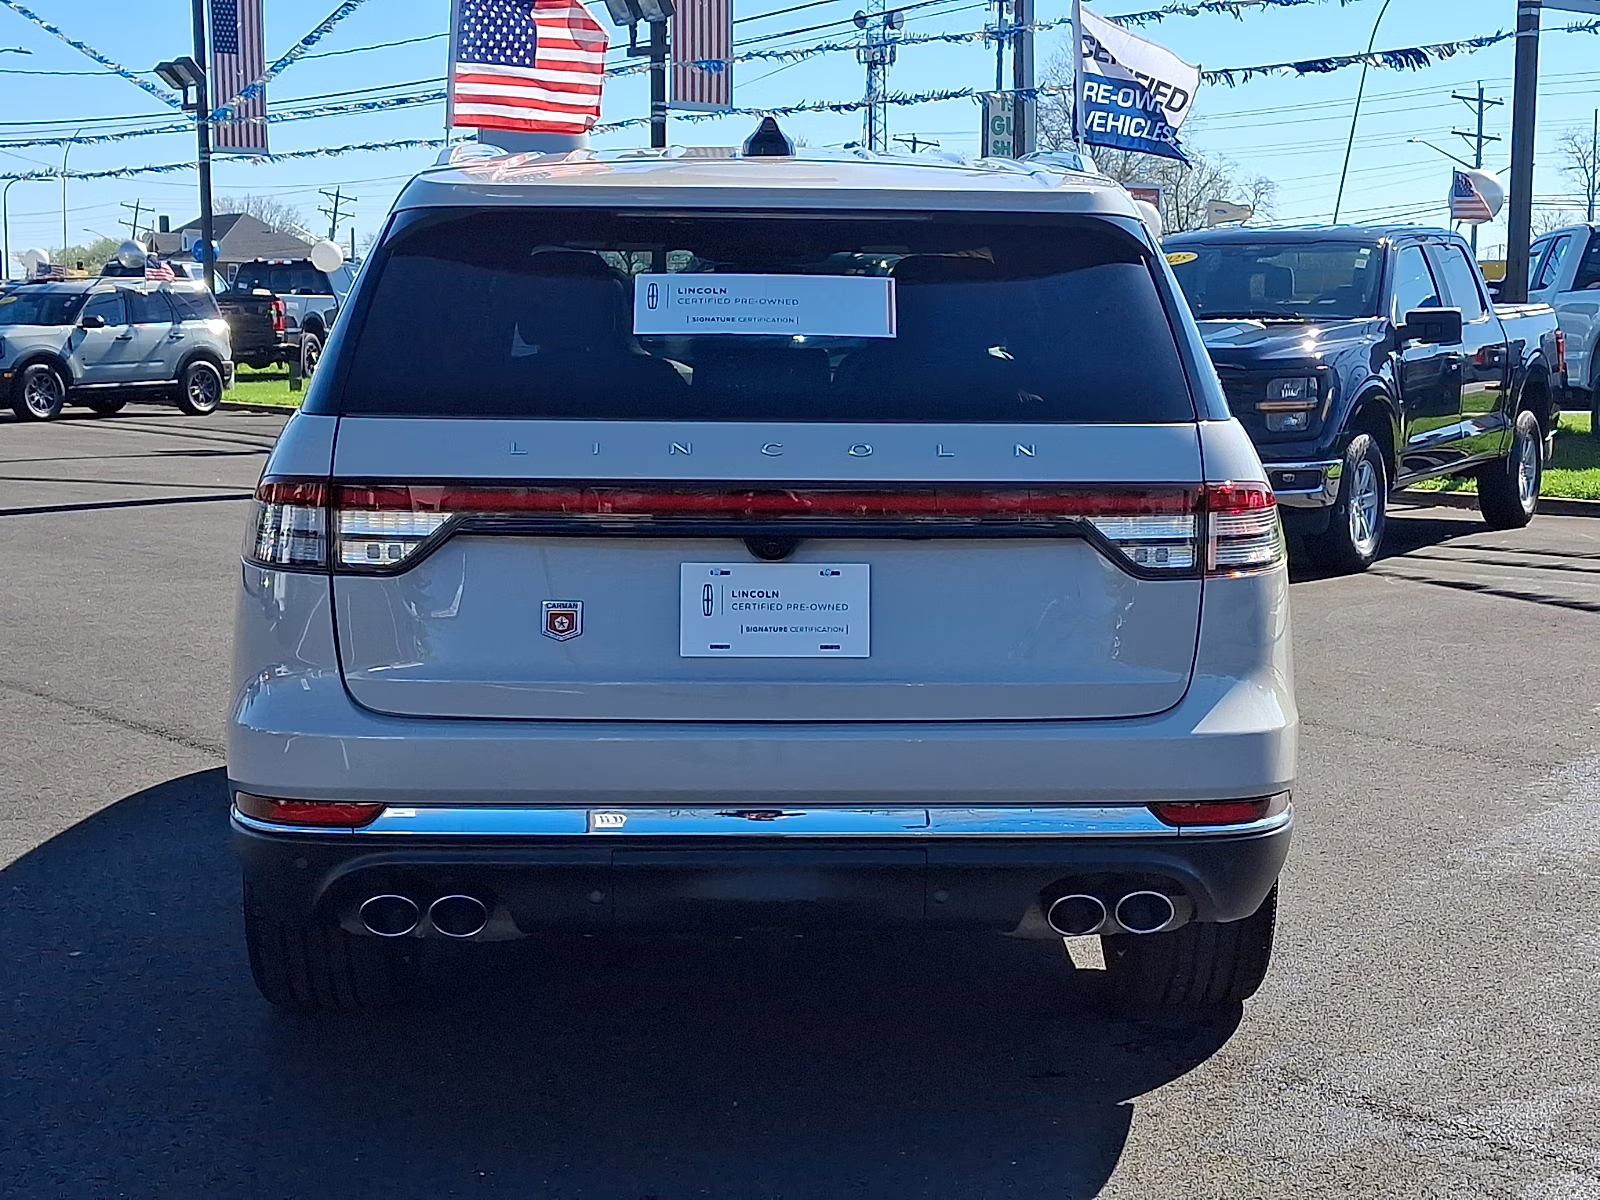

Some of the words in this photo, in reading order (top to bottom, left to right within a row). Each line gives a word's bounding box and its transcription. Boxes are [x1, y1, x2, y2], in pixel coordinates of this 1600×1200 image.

[677, 287, 727, 295] LINCOLN
[677, 297, 731, 305] CERTIFIED
[734, 298, 799, 306] PRE-OWNED
[691, 315, 736, 323] SIGNATURE
[738, 316, 795, 324] CERTIFICATION
[509, 441, 1037, 457] LINCOLN
[731, 590, 780, 599] LINCOLN
[731, 602, 783, 611] CERTIFIED
[786, 602, 849, 611] PRE-OWNED
[745, 625, 788, 633] SIGNATURE
